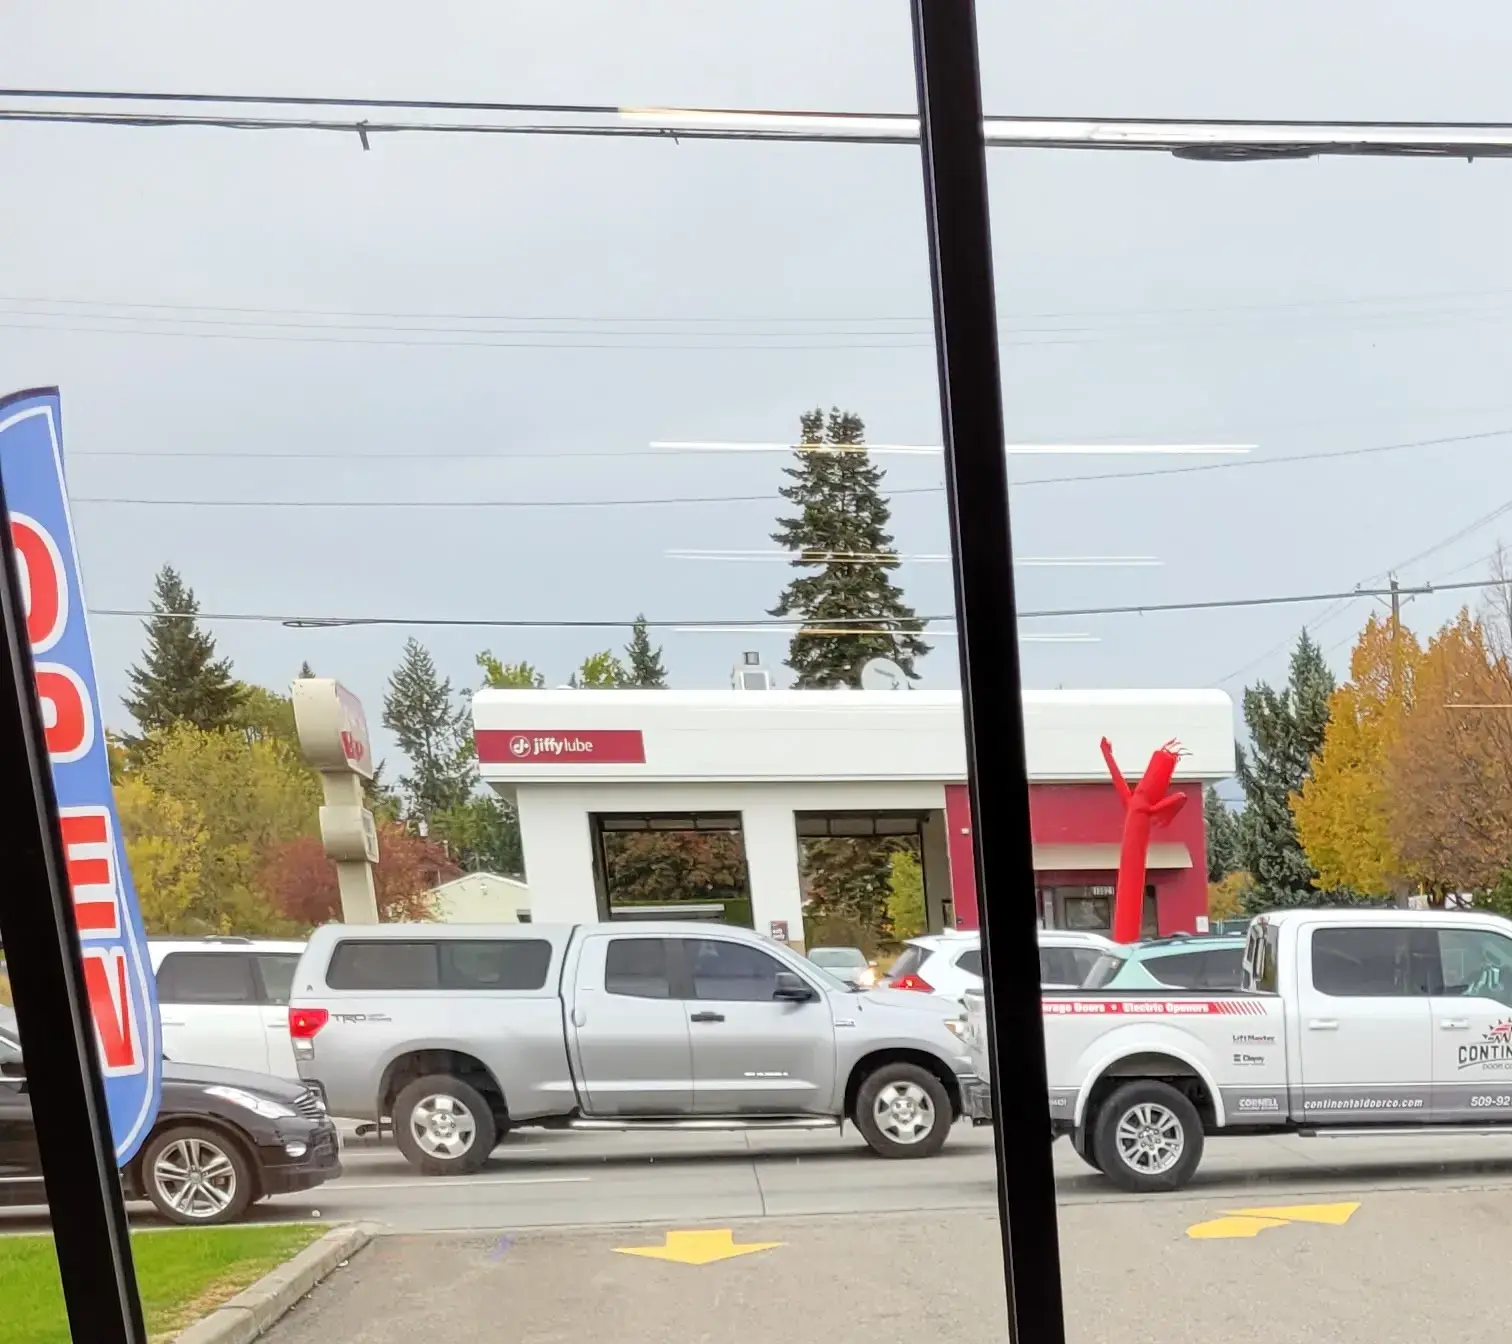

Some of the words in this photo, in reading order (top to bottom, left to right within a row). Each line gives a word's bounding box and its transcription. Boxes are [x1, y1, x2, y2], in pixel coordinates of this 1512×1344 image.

[533, 737, 564, 755] jiffy
[564, 738, 593, 752] lube
[1122, 1001, 1164, 1013] Electric
[1304, 1098, 1423, 1110] continentaldoorco.com
